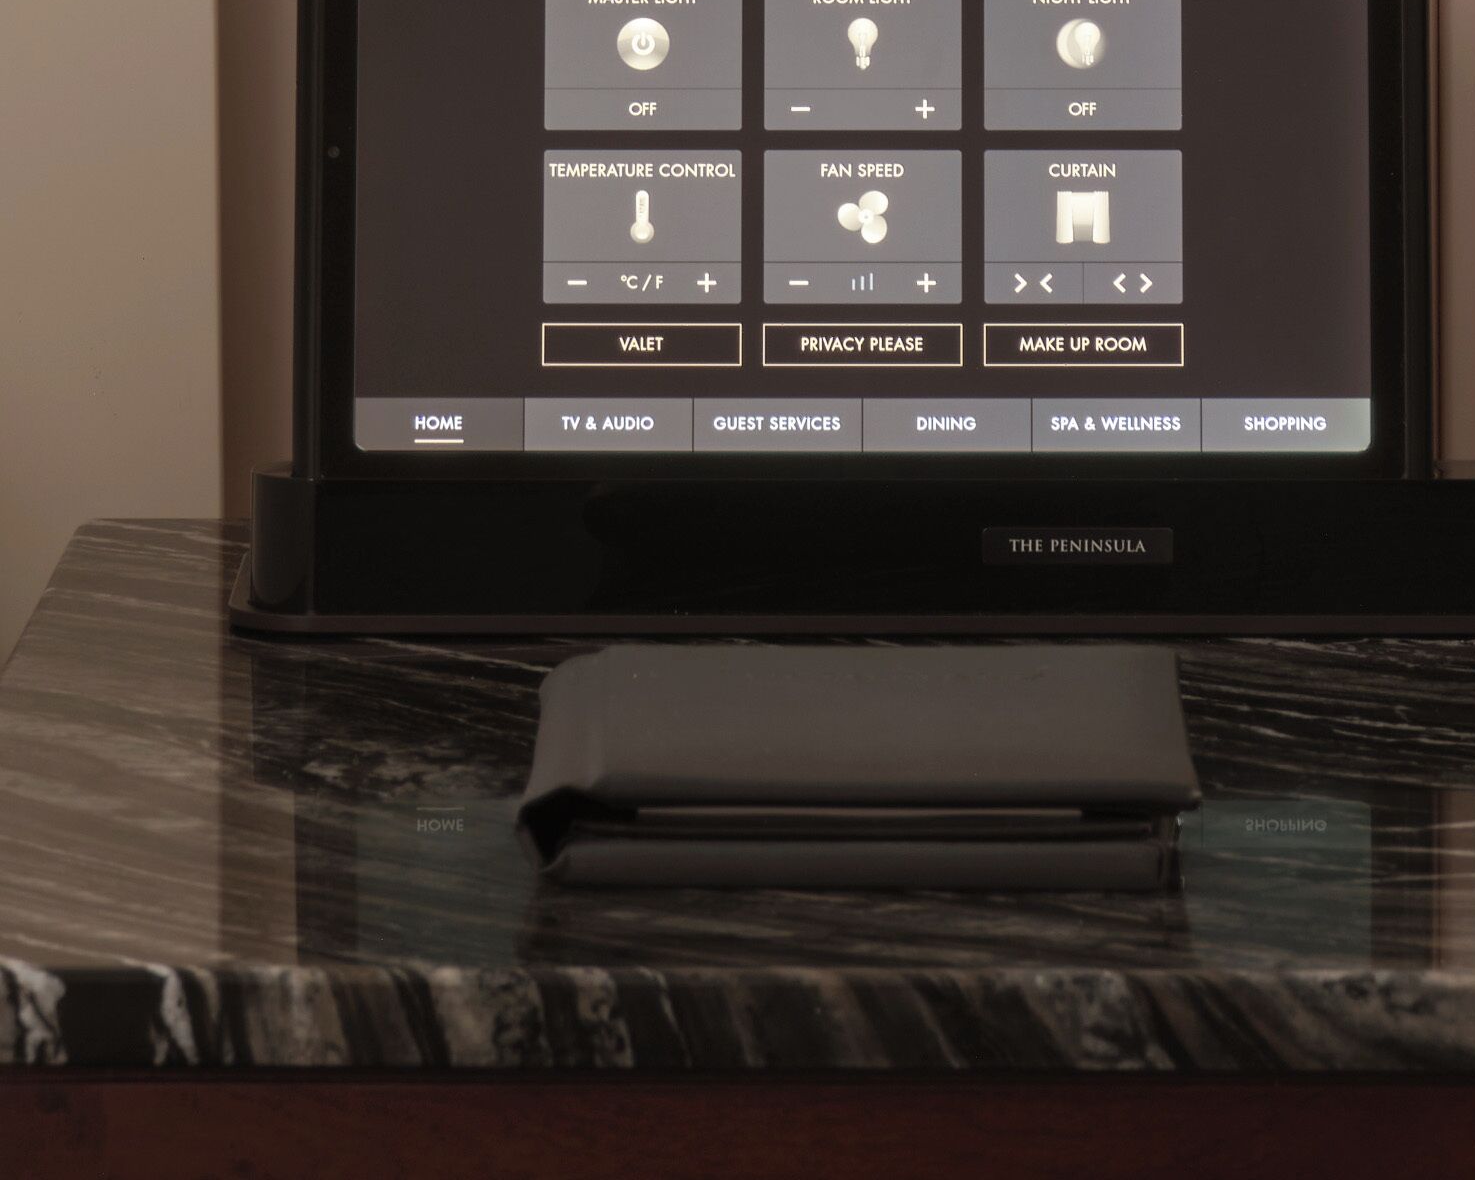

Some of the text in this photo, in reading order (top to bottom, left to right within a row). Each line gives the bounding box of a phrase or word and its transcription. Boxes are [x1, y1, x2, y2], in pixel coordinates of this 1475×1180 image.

[629, 102, 656, 116] OFF
[1069, 102, 1096, 116] OFF
[549, 163, 735, 177] TEMPERATURE CONTROL
[821, 164, 904, 177] FAN SPEED
[1049, 164, 1115, 177] CURTAIN
[619, 337, 663, 351] VALET
[801, 337, 923, 351] PRIVACY PLEASE
[1020, 337, 1146, 351] MAKE UP ROOM
[415, 416, 462, 430] HOME
[562, 416, 654, 430] TV & AUDIO
[714, 416, 840, 430] GUEST SERVICES
[917, 417, 976, 430] DINING
[1051, 416, 1181, 431] SPA & WELLNESS
[1245, 417, 1326, 430] SHOPPING
[1009, 540, 1145, 552] THE PENINSULA
